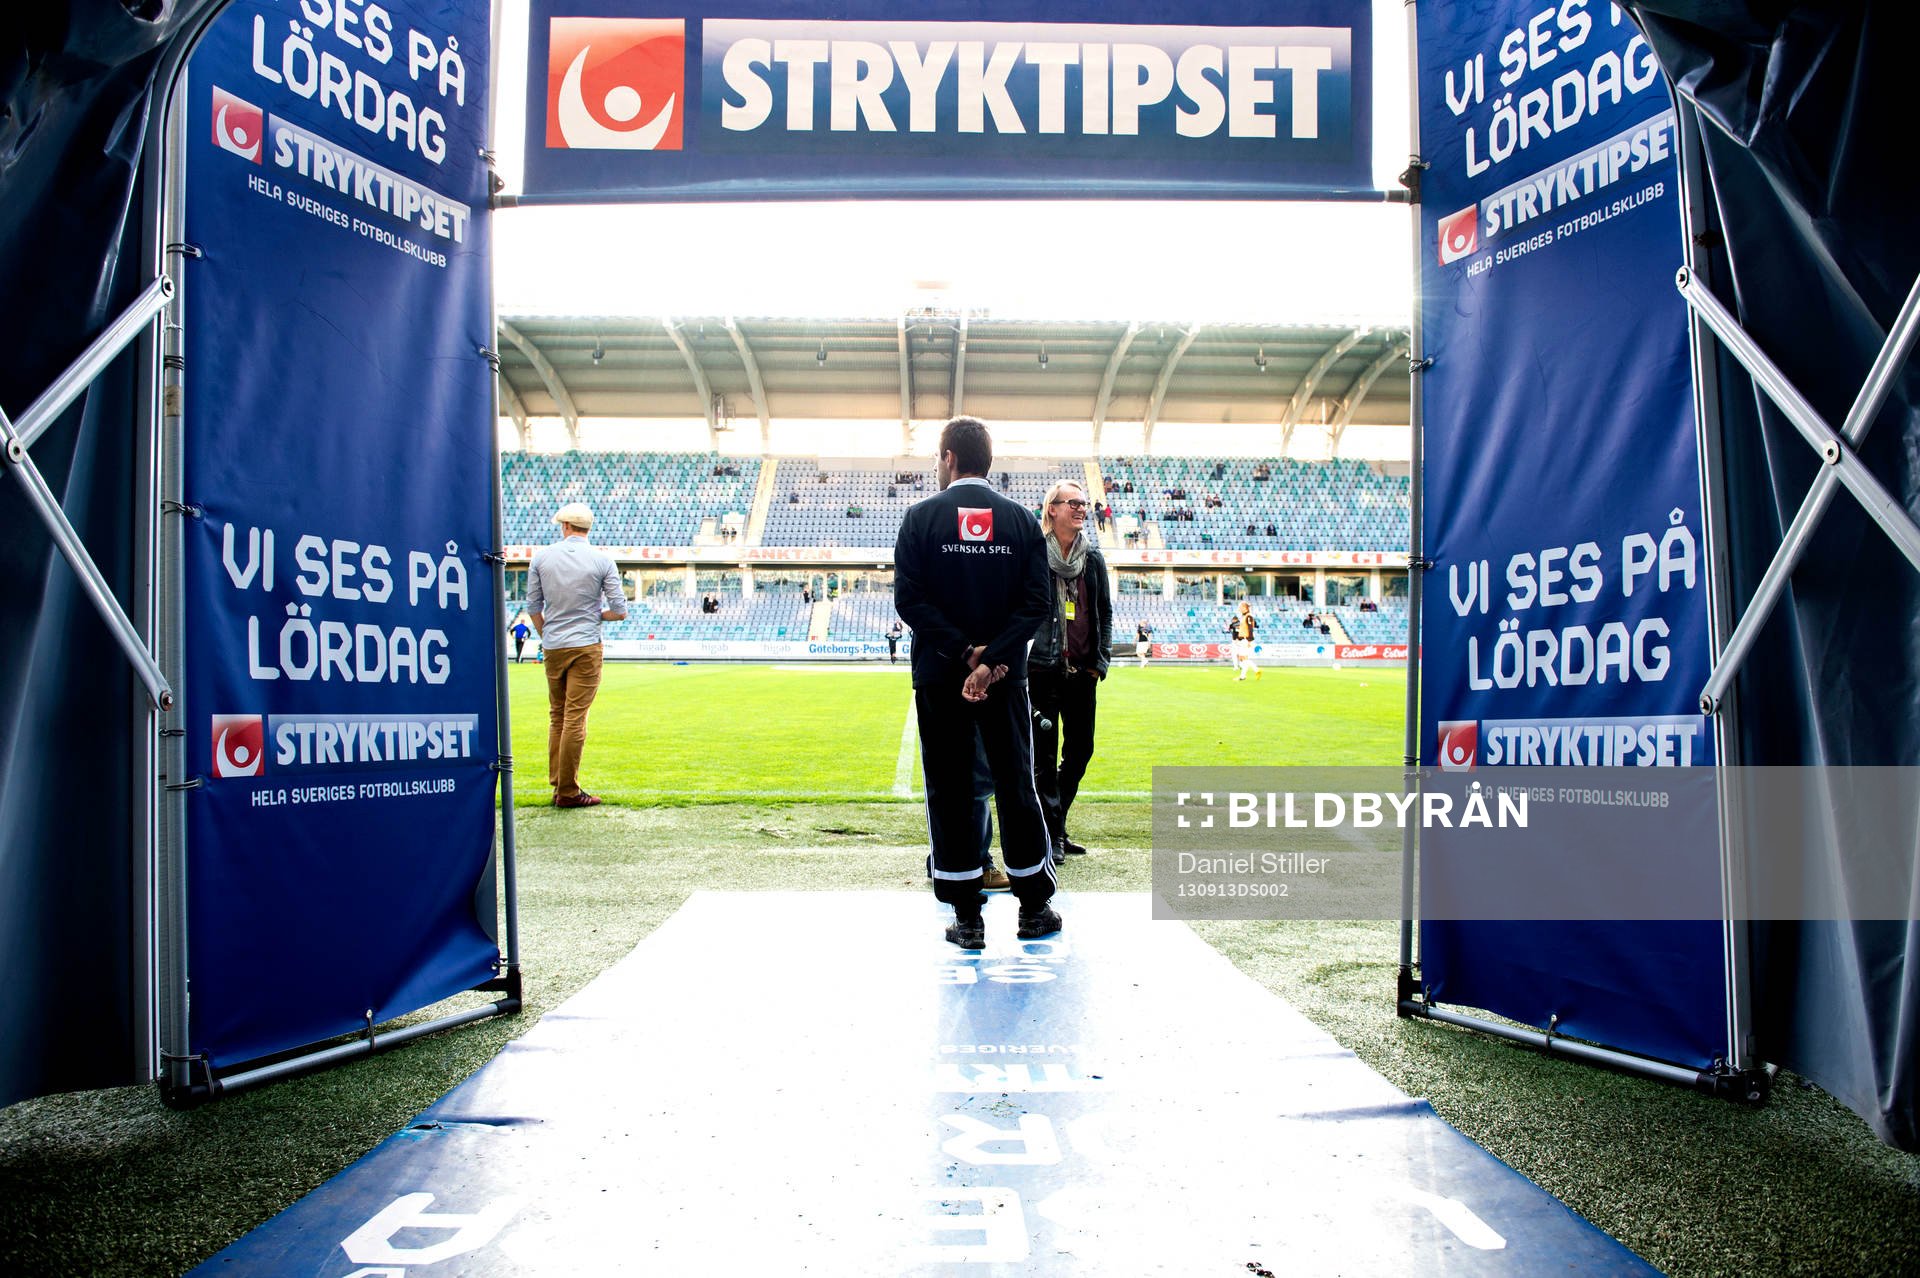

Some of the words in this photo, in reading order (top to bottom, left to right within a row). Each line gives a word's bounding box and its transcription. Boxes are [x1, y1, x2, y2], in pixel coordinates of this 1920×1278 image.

[253, 14, 447, 165] LÖRDAG
[409, 28, 465, 107] PÅ
[721, 38, 1331, 139] STRYKTIPSET
[1445, 53, 1484, 116] VI
[1499, 0, 1593, 88] SES
[1465, 33, 1660, 179] LÖRDAG
[248, 174, 282, 202] HELA
[287, 191, 349, 229] SVERIGES
[353, 218, 447, 269] FOTBOLLSKLUBB
[275, 127, 467, 244] STRYKTIPSET
[1467, 256, 1493, 278] HELA
[1496, 230, 1554, 265] SVERIGES
[1557, 182, 1665, 241] FOTBOLLSKLUBB
[223, 522, 274, 592] VI
[295, 534, 393, 603] SES
[408, 540, 468, 610] PÅ
[941, 544, 986, 554] SVENSKA
[989, 545, 1013, 555] SPEL
[1449, 559, 1489, 617] VI
[1506, 542, 1603, 610] SES
[1622, 507, 1696, 597] PÅ
[248, 602, 450, 685] LÖRDAG
[1469, 617, 1670, 691] LÖRDAG
[276, 721, 474, 766] STRYKTIPSET
[1486, 724, 1698, 768] STRYKTIPSET
[252, 791, 287, 807] HELA
[291, 785, 355, 804] SVERIGES
[359, 778, 456, 798] FOTBOLLSKLUBB
[1465, 785, 1494, 799] HLA
[1559, 788, 1670, 808] FOTBOLLSKLUBB
